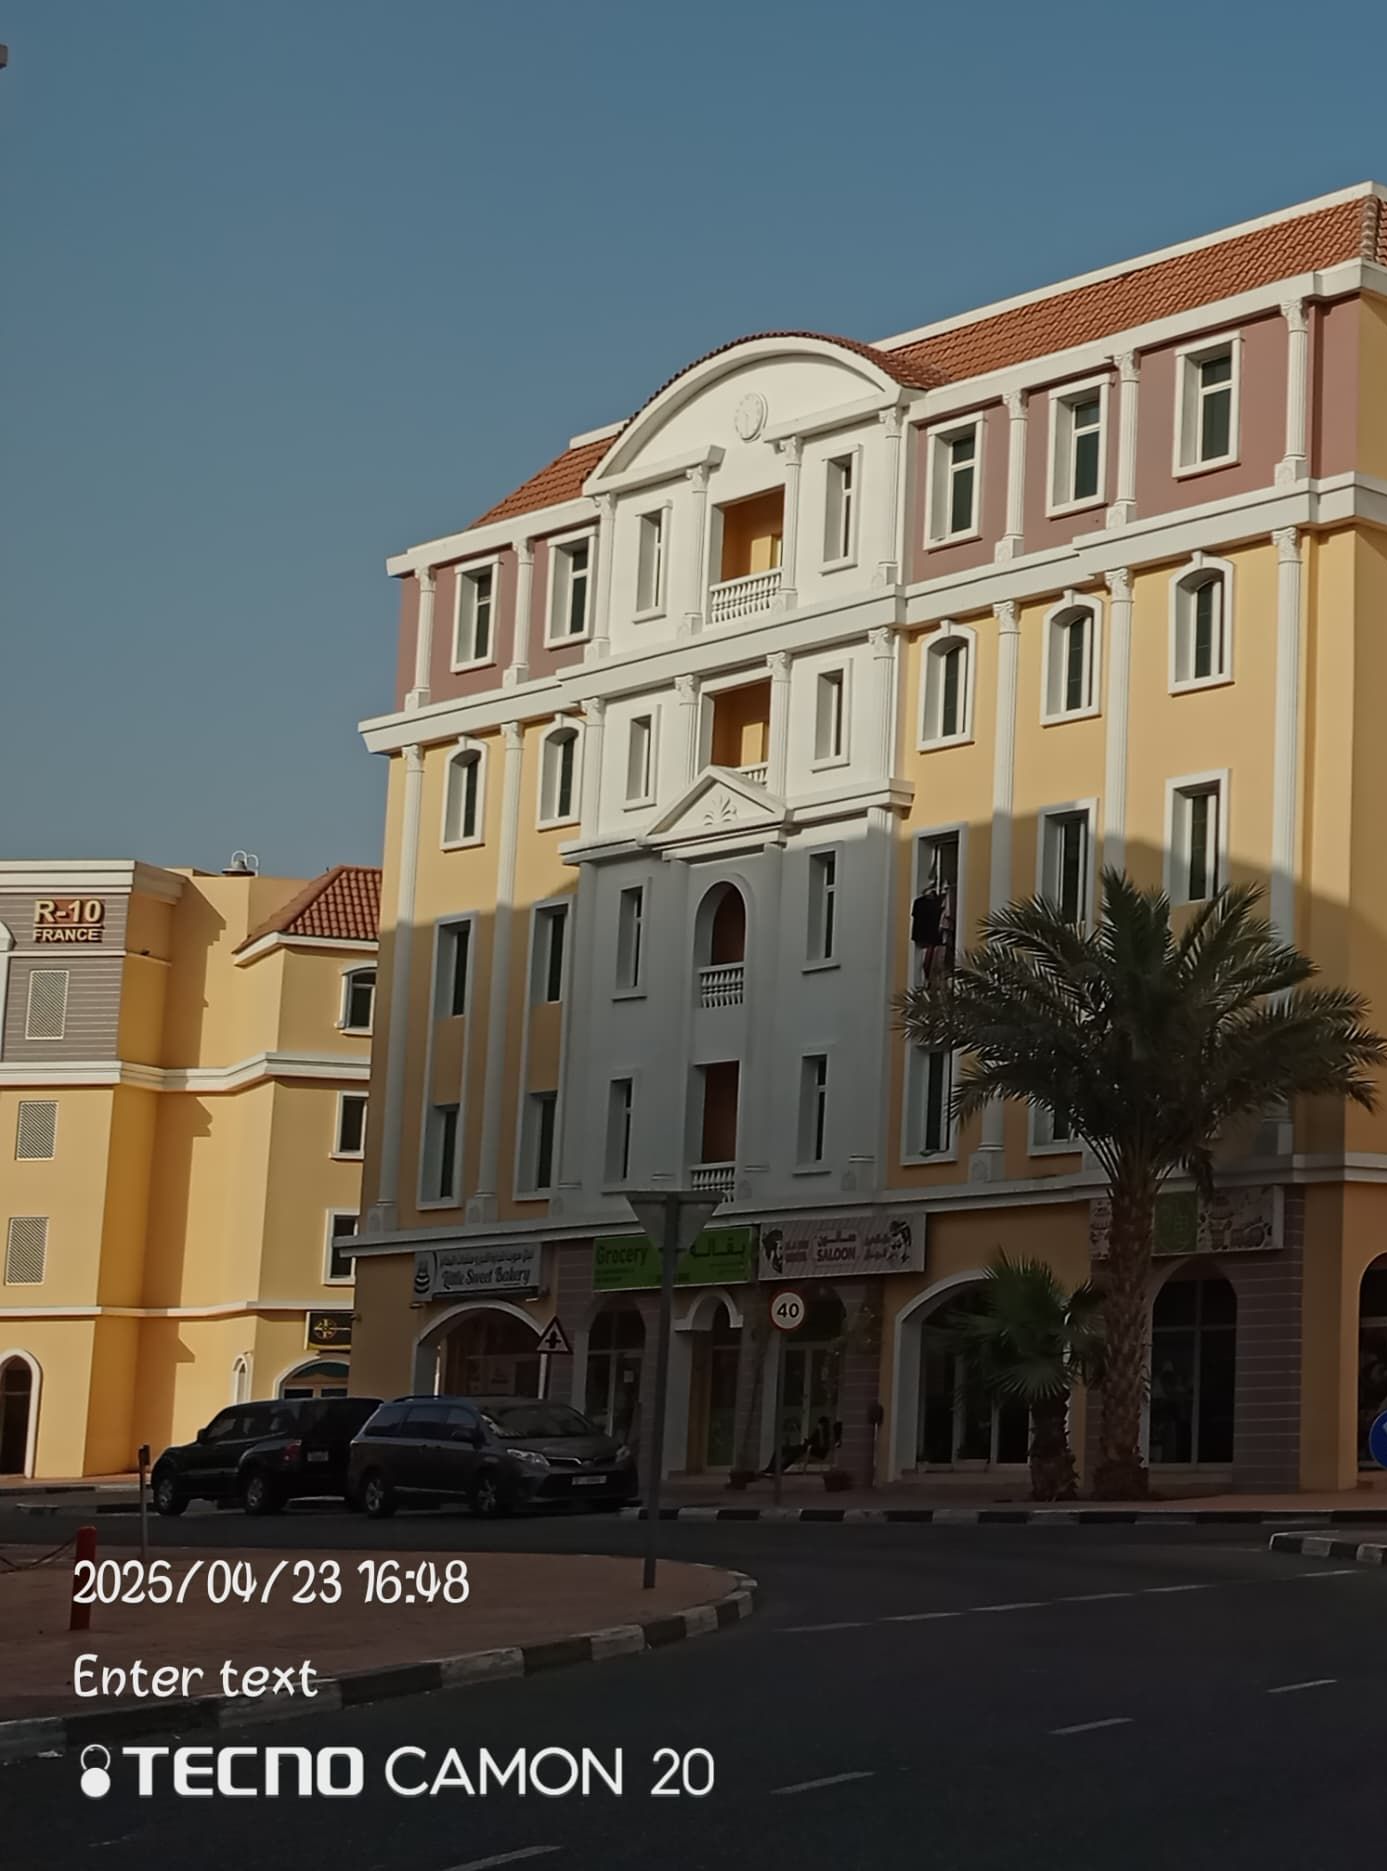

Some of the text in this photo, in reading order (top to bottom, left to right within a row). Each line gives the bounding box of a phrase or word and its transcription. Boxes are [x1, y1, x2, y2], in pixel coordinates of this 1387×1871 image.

[34, 899, 104, 923] R-10
[33, 928, 102, 942] FRANCE
[596, 1246, 649, 1266] Grocery
[817, 1247, 857, 1262] SALOON
[465, 1268, 493, 1285] Sweet
[495, 1266, 531, 1286] Bakery
[777, 1303, 799, 1318] 40
